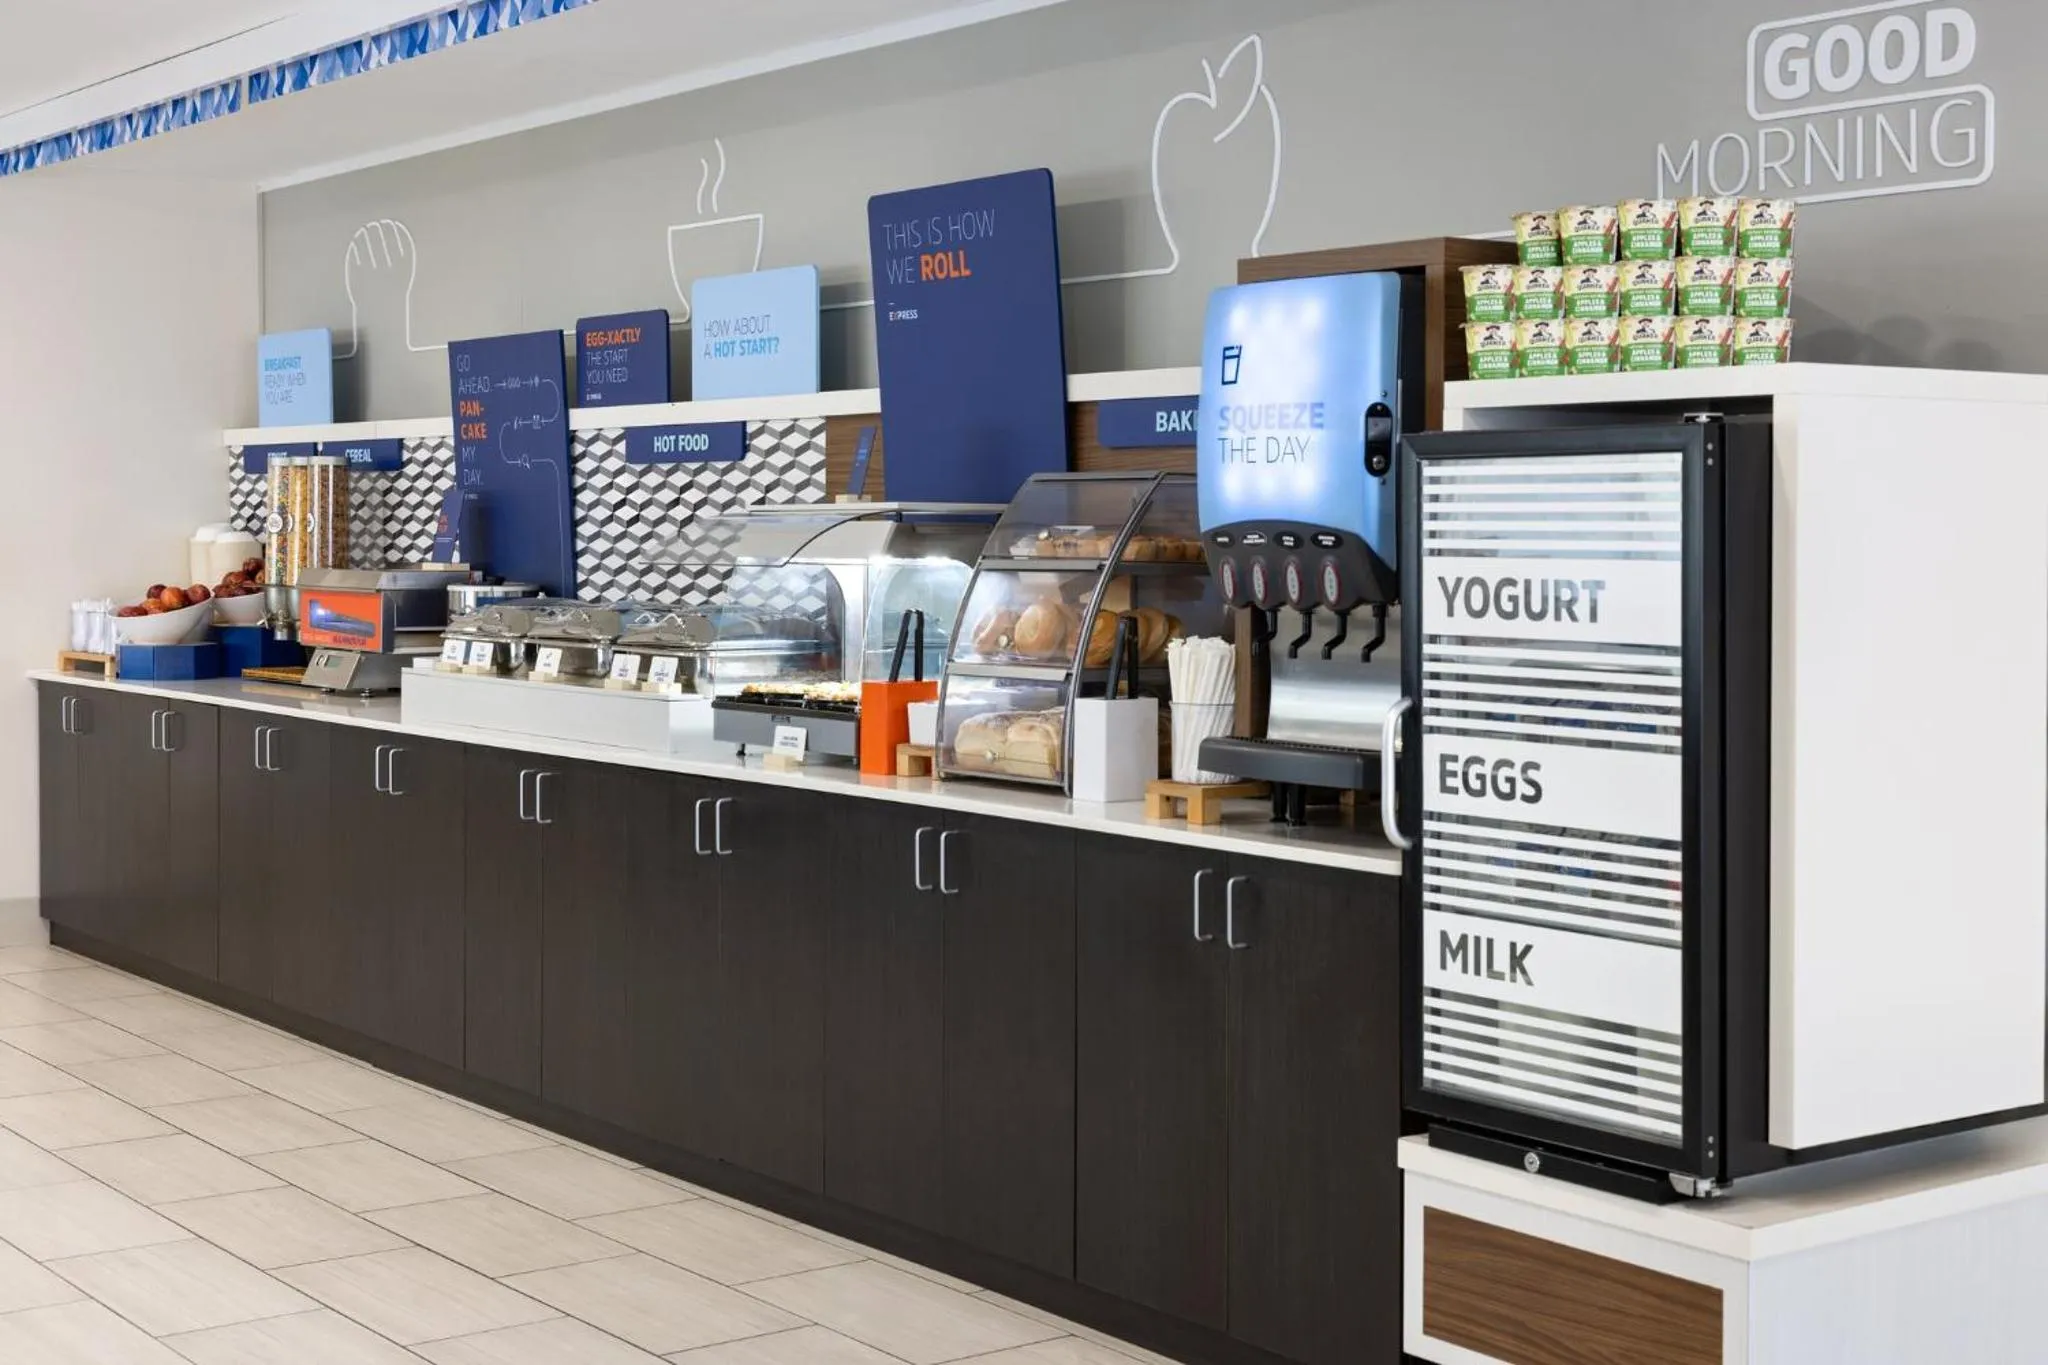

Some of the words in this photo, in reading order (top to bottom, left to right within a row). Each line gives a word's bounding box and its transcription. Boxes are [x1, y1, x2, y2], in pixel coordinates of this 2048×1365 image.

[1763, 8, 1976, 100] GOOD
[1656, 99, 1976, 199] MORNING
[882, 219, 922, 250] THIS
[928, 216, 943, 245] IS
[948, 208, 995, 241] HOW
[886, 256, 916, 284] WE
[920, 250, 973, 281] ROLL
[889, 309, 918, 321] EXPRESS
[585, 327, 641, 346] EGG-XACTLY
[704, 319, 731, 338] HOW
[734, 314, 771, 335] ABOUT
[586, 350, 603, 366] THE
[604, 349, 629, 365] START
[704, 346, 713, 360] A
[714, 340, 735, 358] HOT
[740, 337, 780, 355] START?
[264, 356, 301, 372] BREAKFAST
[456, 355, 471, 372] GO
[587, 370, 604, 385] YOU
[606, 368, 628, 383] NEED
[459, 401, 485, 417] PAN-
[1218, 403, 1325, 432] SQUEEZE
[460, 423, 488, 440] CAKE
[654, 436, 675, 452] HOT
[678, 434, 709, 451] FOOD
[1217, 436, 1257, 464] THE
[1266, 435, 1311, 464] DAY
[345, 448, 373, 463] CEREAL
[462, 446, 476, 462] MY
[1438, 576, 1606, 624] YOGURT
[1439, 753, 1543, 804] EGGS
[1439, 929, 1534, 986] MILK
